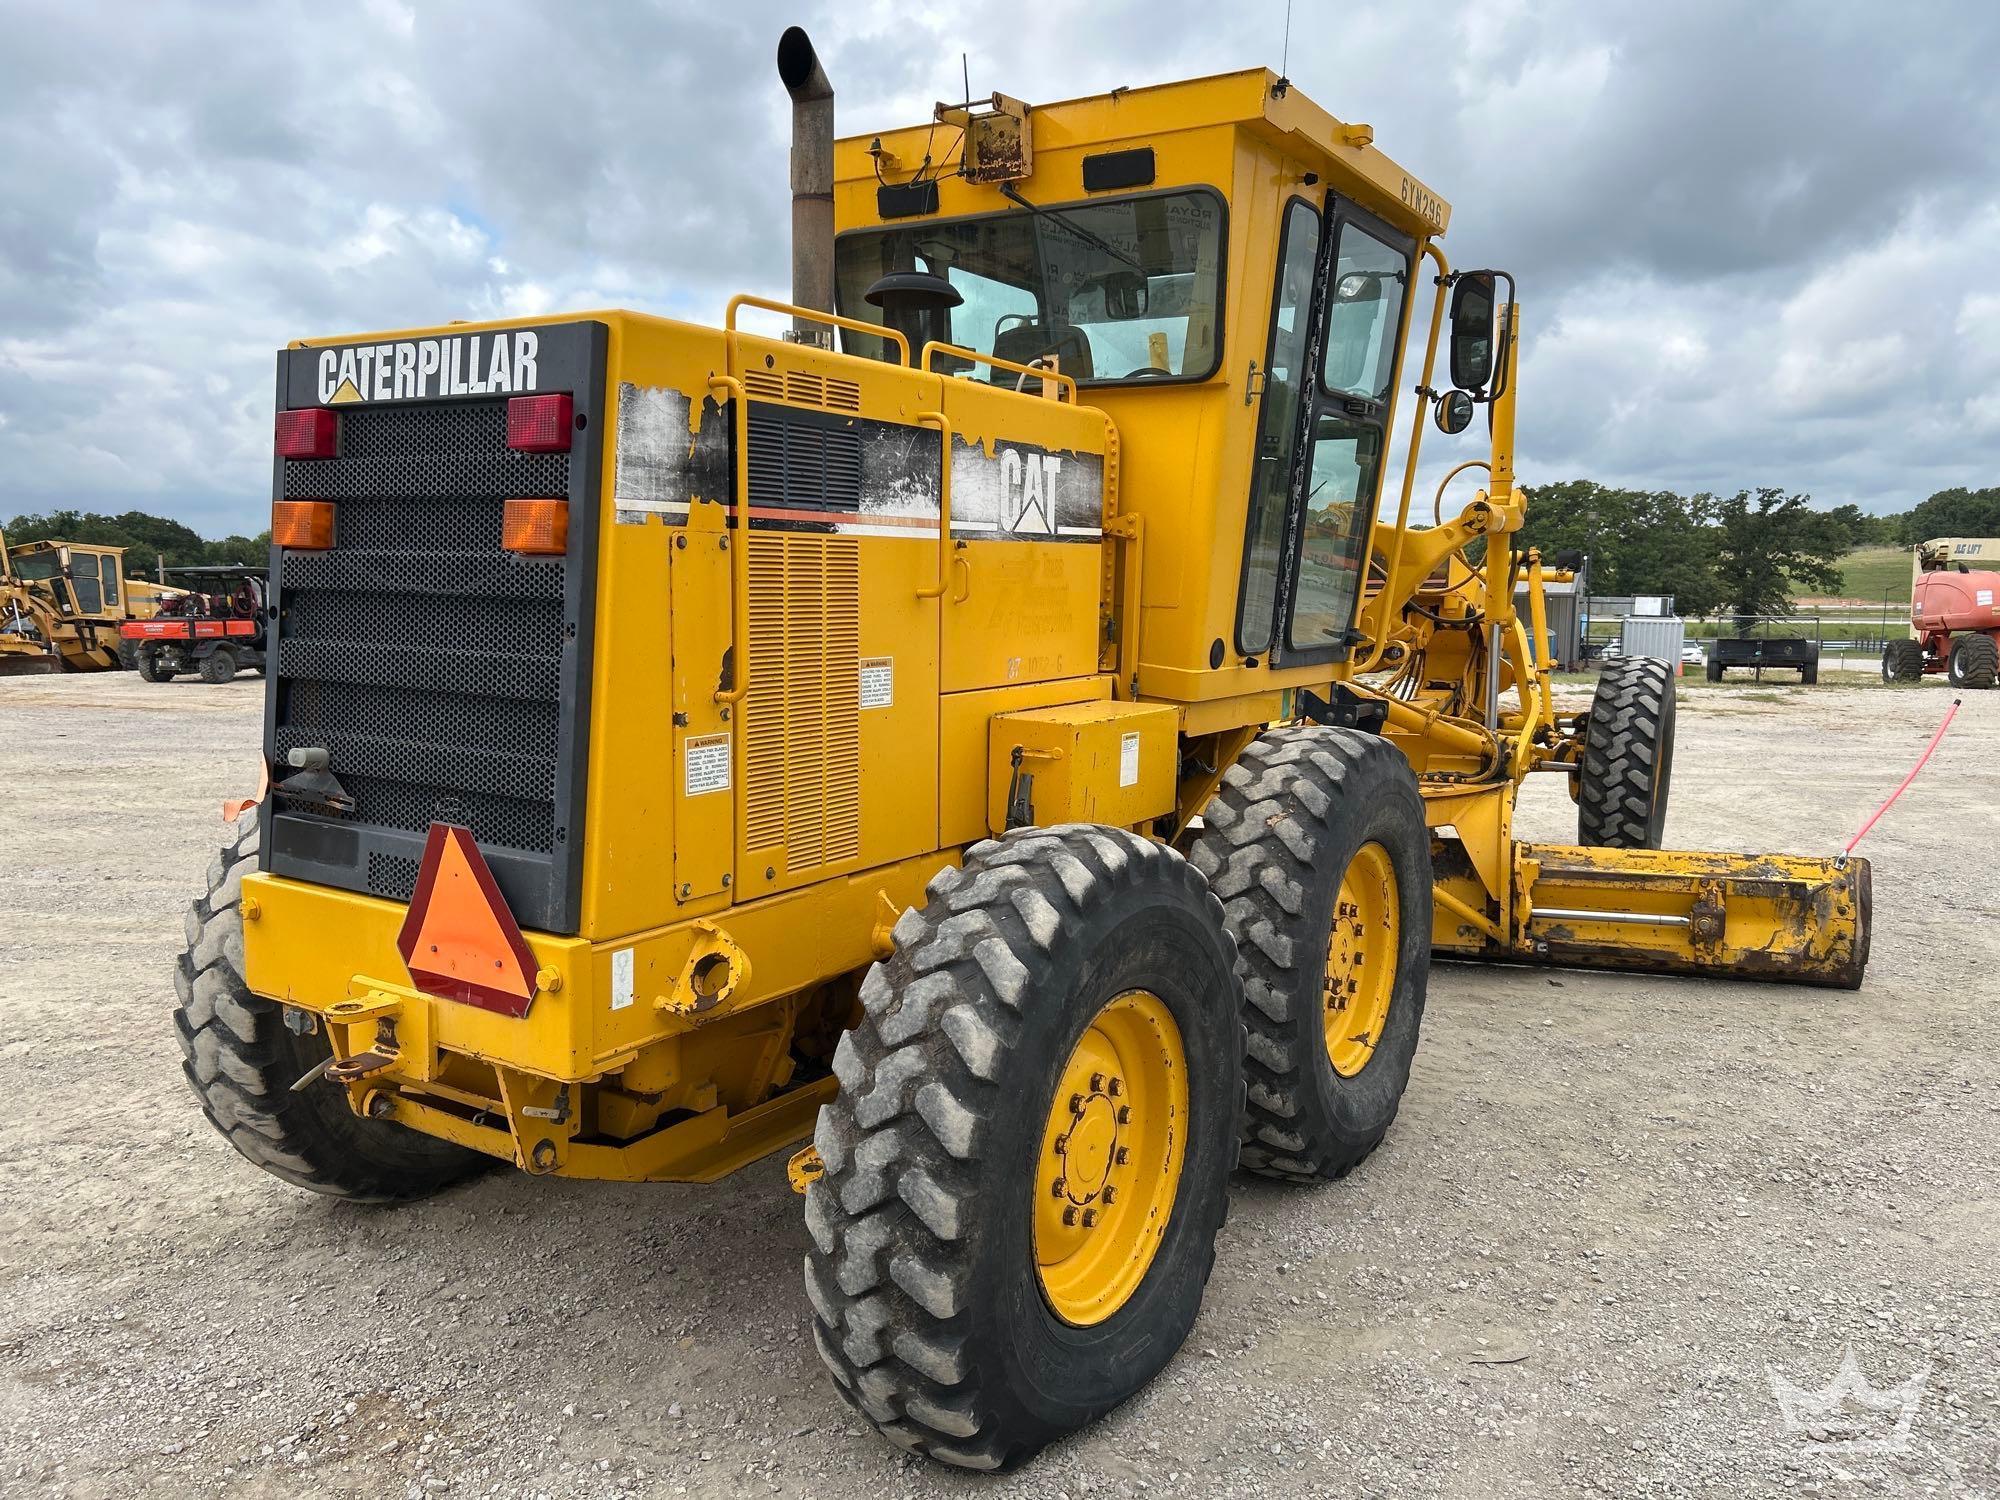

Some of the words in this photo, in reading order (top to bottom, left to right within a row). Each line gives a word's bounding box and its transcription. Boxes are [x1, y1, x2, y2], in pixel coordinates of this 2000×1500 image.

[1401, 177, 1442, 226] 6YN296
[318, 331, 538, 404] CATERPILLAR
[1000, 448, 1061, 534] CAT
[700, 738, 722, 746] WARNING
